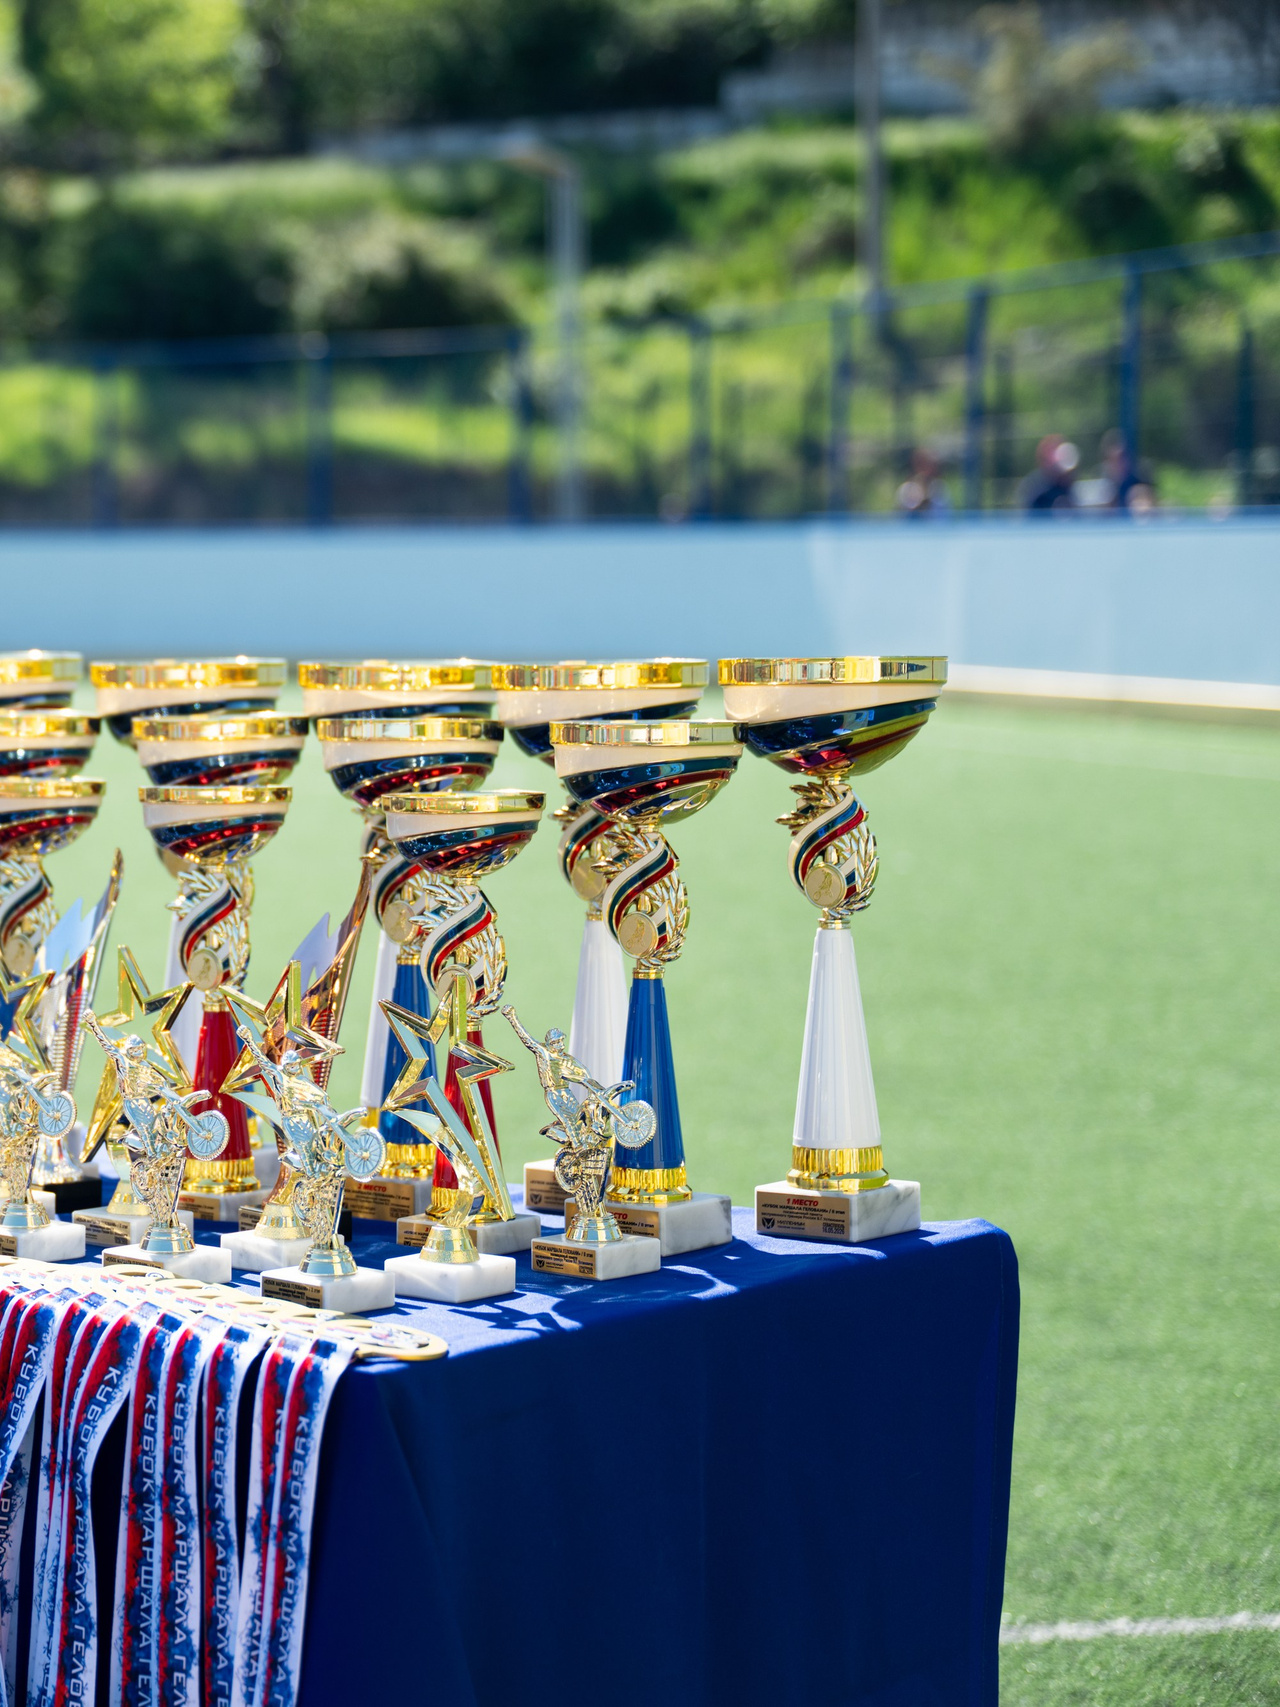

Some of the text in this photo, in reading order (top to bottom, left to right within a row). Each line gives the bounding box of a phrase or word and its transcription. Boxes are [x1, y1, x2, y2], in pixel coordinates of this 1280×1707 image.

[792, 1198, 819, 1207] МЕСТО
[4, 1344, 38, 1438] КУБОК
[76, 1366, 121, 1461] КУБОК
[173, 1382, 187, 1484] КУБОК
[142, 1394, 156, 1492] КУБОК
[214, 1407, 226, 1509] КУБОК
[74, 1472, 87, 1615] МАРШАЛА
[139, 1504, 155, 1648] МАРШАЛА
[174, 1495, 187, 1644] МАРШАЛА
[276, 1416, 310, 1682] КУБОК МАРШАЛА
[215, 1520, 229, 1670] МАРШАЛА
